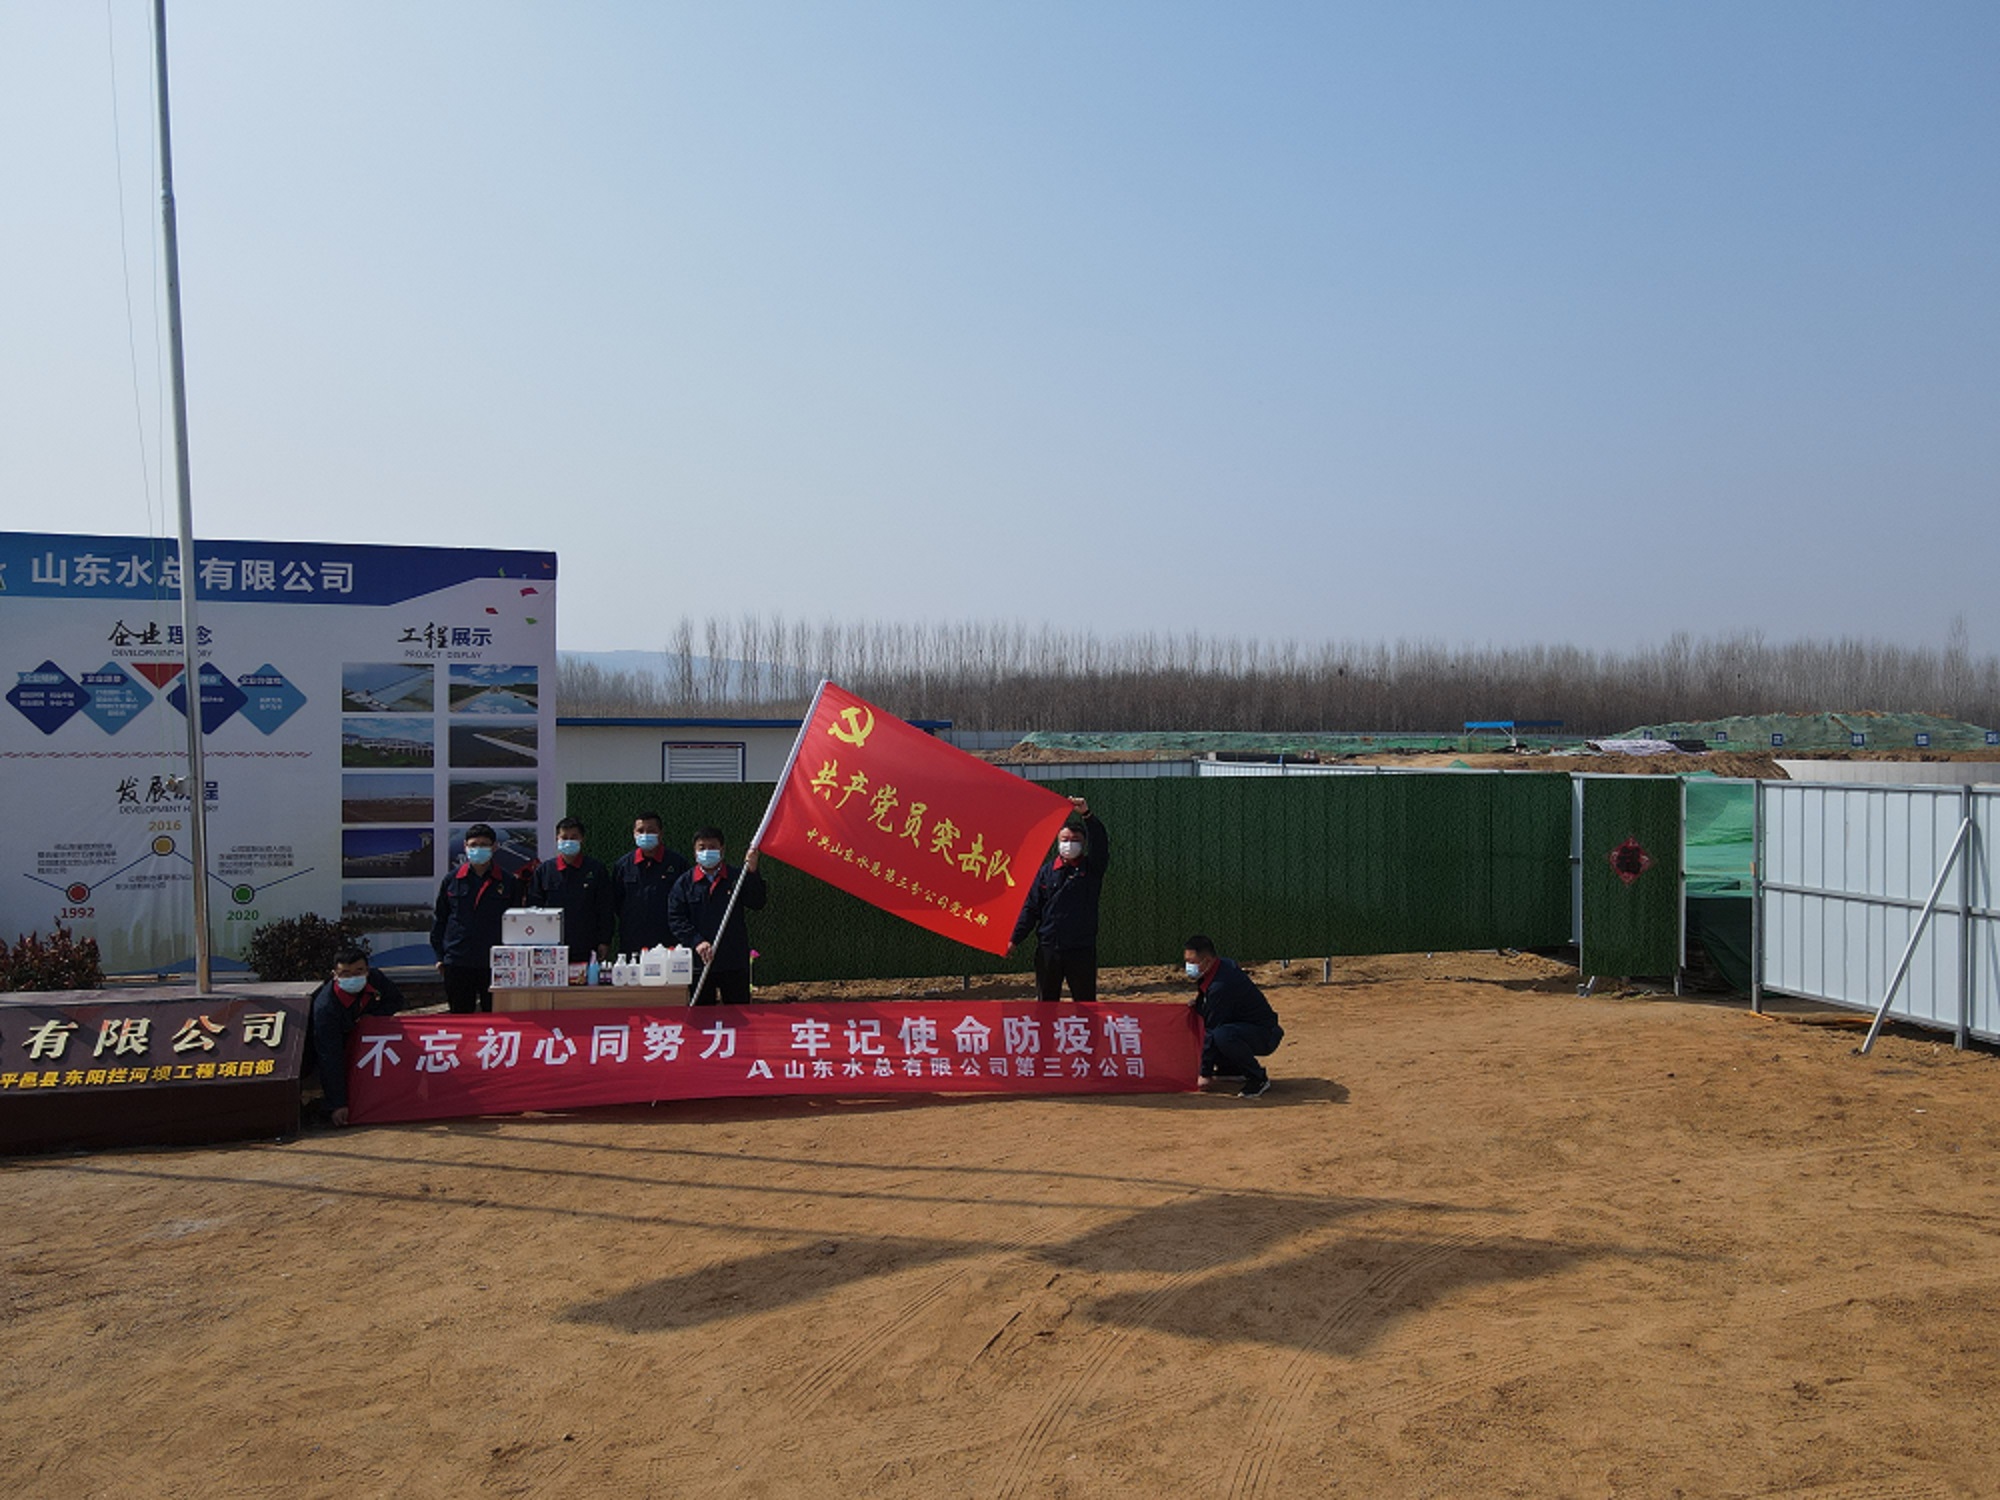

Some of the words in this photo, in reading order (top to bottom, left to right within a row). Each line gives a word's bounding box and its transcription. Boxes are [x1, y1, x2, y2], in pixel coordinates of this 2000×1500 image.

[32, 552, 353, 593] 山东水总有限公司
[108, 620, 212, 646] 企业理念
[397, 622, 492, 650] 工程展示
[405, 649, 441, 659] PROJECT
[447, 651, 483, 659] DISPLAY
[119, 804, 181, 815] DEVELOPMENT
[148, 820, 182, 832] 2016
[811, 759, 1015, 887] 共产党员突击队
[61, 907, 95, 919] 1992
[226, 909, 259, 921] 2020
[22, 1010, 286, 1059] 有限公司
[357, 1020, 737, 1077] 不忘初心同努力
[791, 1014, 1143, 1057] 牢记使命防疫情
[785, 1056, 1146, 1078] 山东水总有限公司第三分公司
